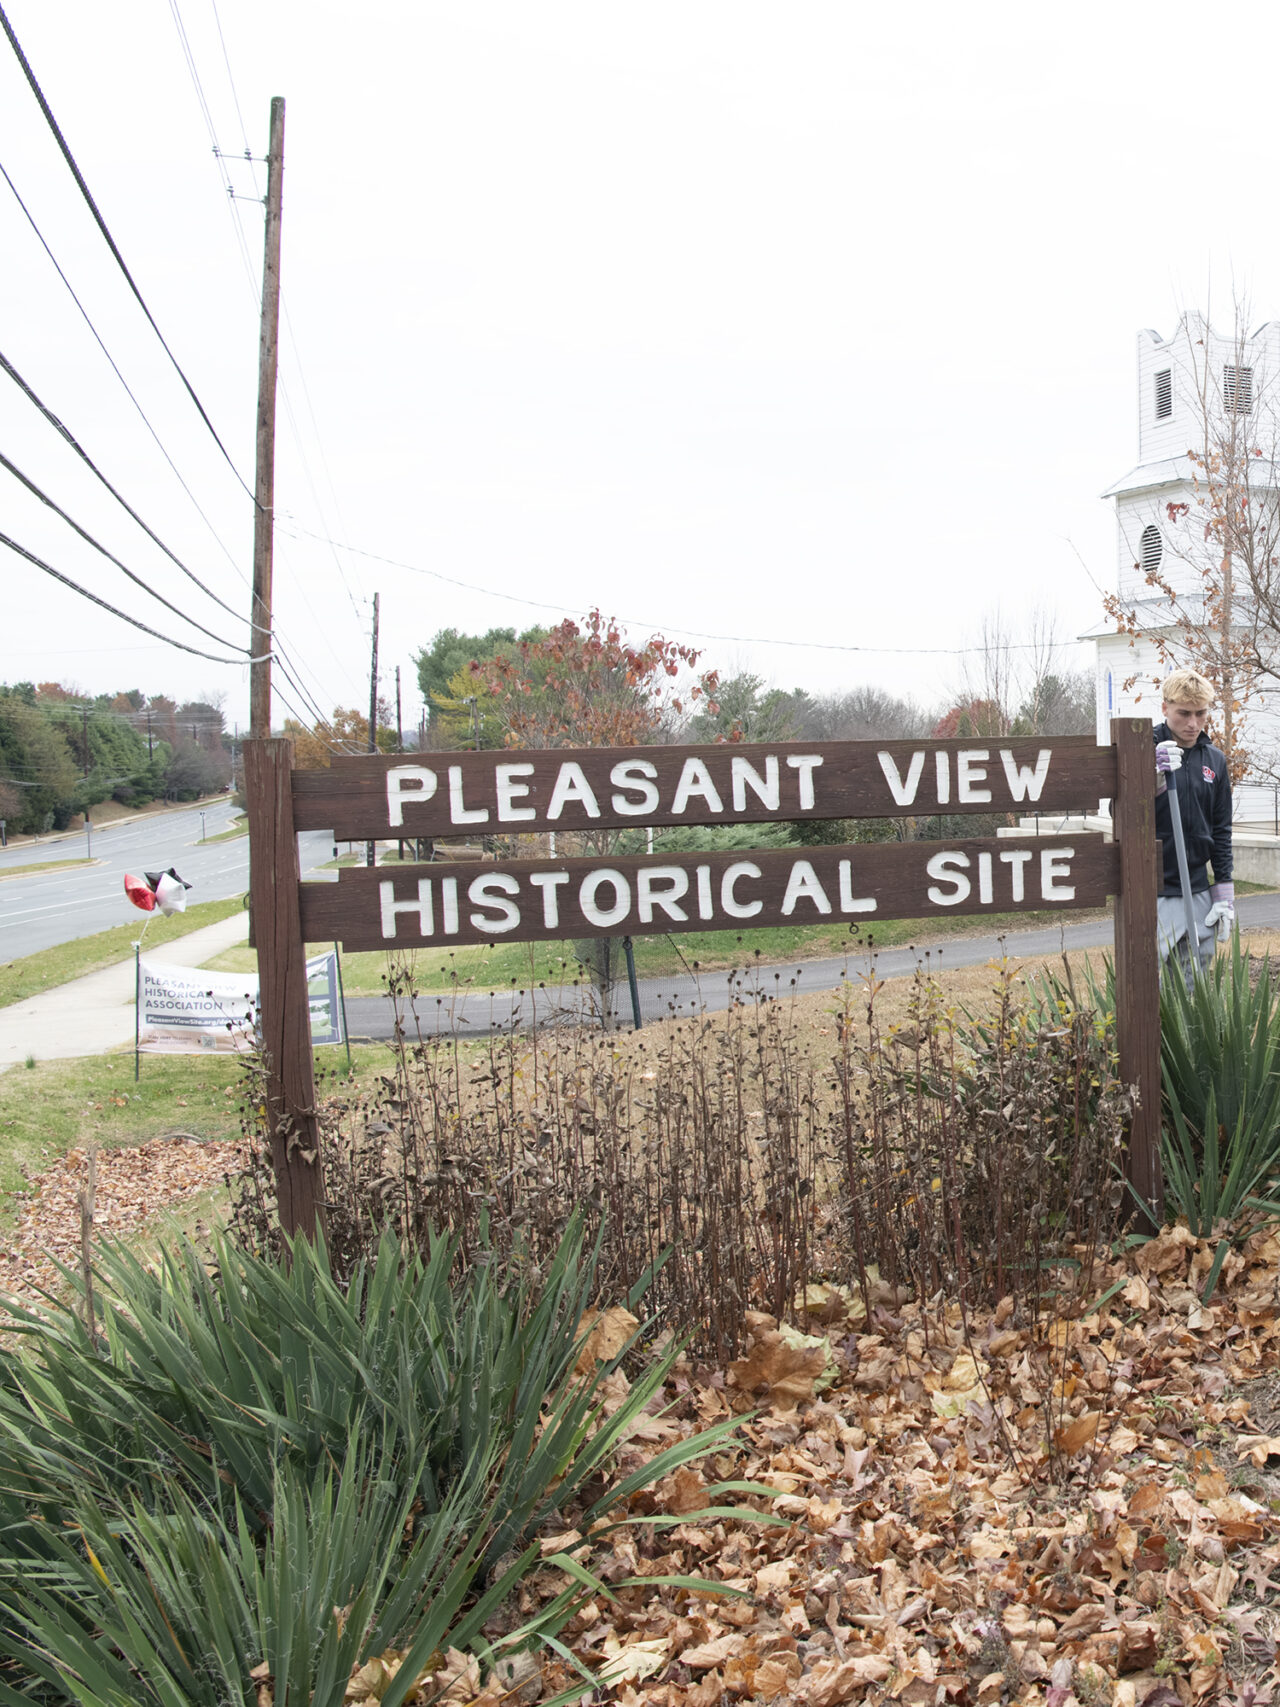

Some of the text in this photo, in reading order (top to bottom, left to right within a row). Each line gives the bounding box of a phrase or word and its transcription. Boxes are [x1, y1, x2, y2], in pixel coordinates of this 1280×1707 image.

[386, 748, 1053, 828] PLEASANT VIEW
[379, 847, 1077, 940] HISTORICAL SITE
[144, 999, 223, 1011] ASSOCIATION
